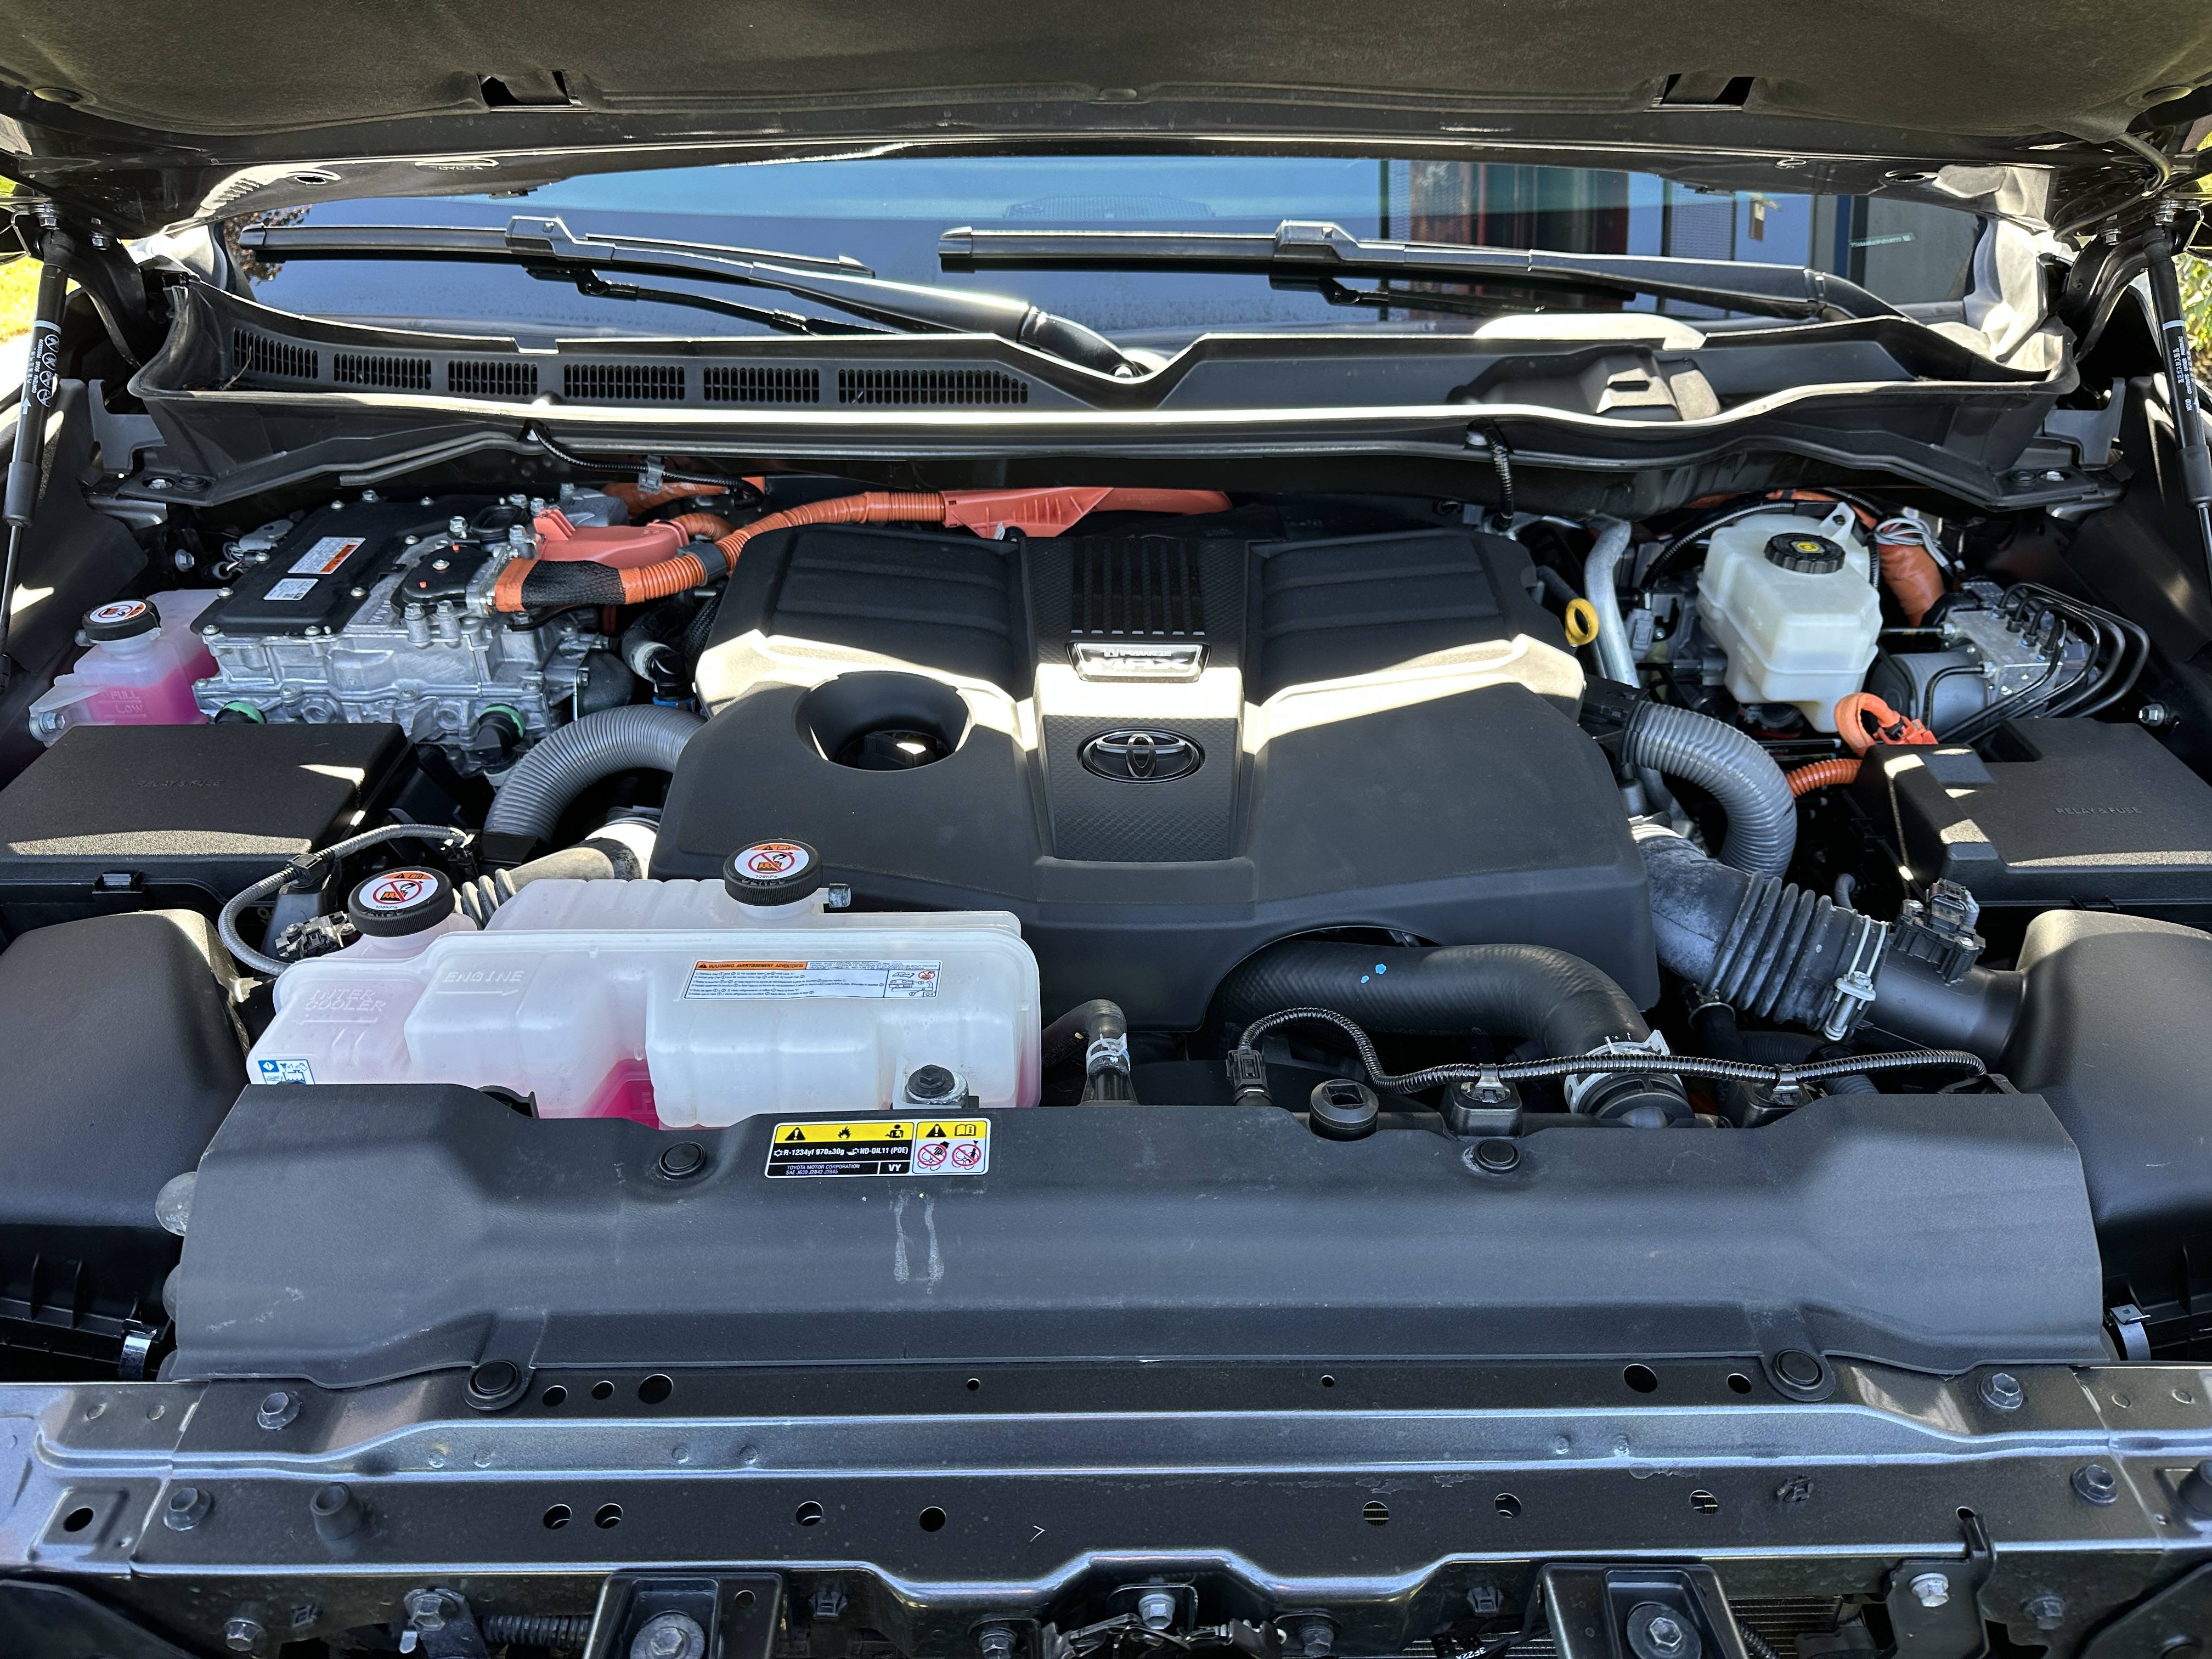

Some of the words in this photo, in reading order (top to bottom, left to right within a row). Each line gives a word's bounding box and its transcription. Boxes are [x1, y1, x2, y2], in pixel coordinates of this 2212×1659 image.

[110, 690, 140, 699] FULL
[114, 704, 143, 713] LOW
[443, 970, 525, 983] ENGINE
[309, 989, 376, 1002] INTER
[304, 999, 386, 1011] COOLER
[816, 1148, 845, 1156] 970±30g
[888, 1164, 902, 1172] VY
